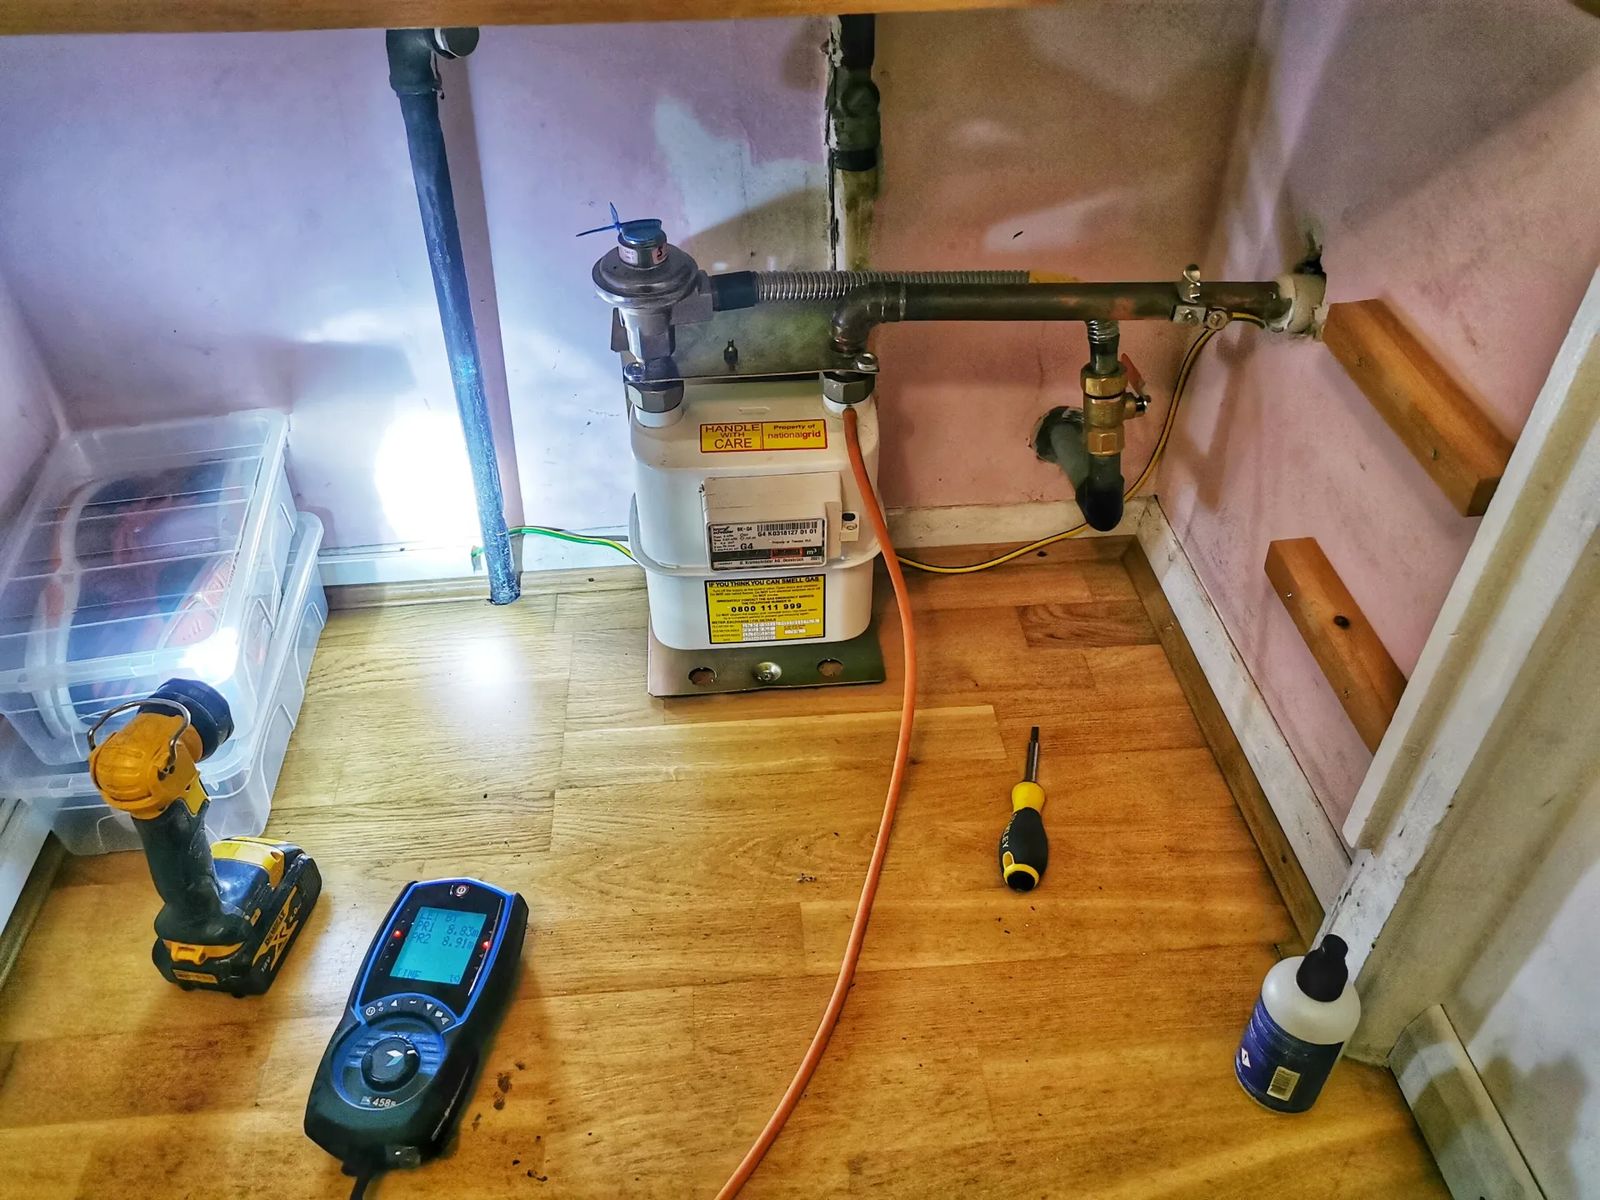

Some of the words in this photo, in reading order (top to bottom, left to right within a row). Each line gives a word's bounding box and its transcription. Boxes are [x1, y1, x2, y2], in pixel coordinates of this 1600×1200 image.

[705, 424, 760, 433] HANDLE
[767, 431, 821, 439] nationalgrid
[714, 438, 752, 449] CARE
[731, 605, 756, 613] 0800
[783, 602, 802, 610] 999
